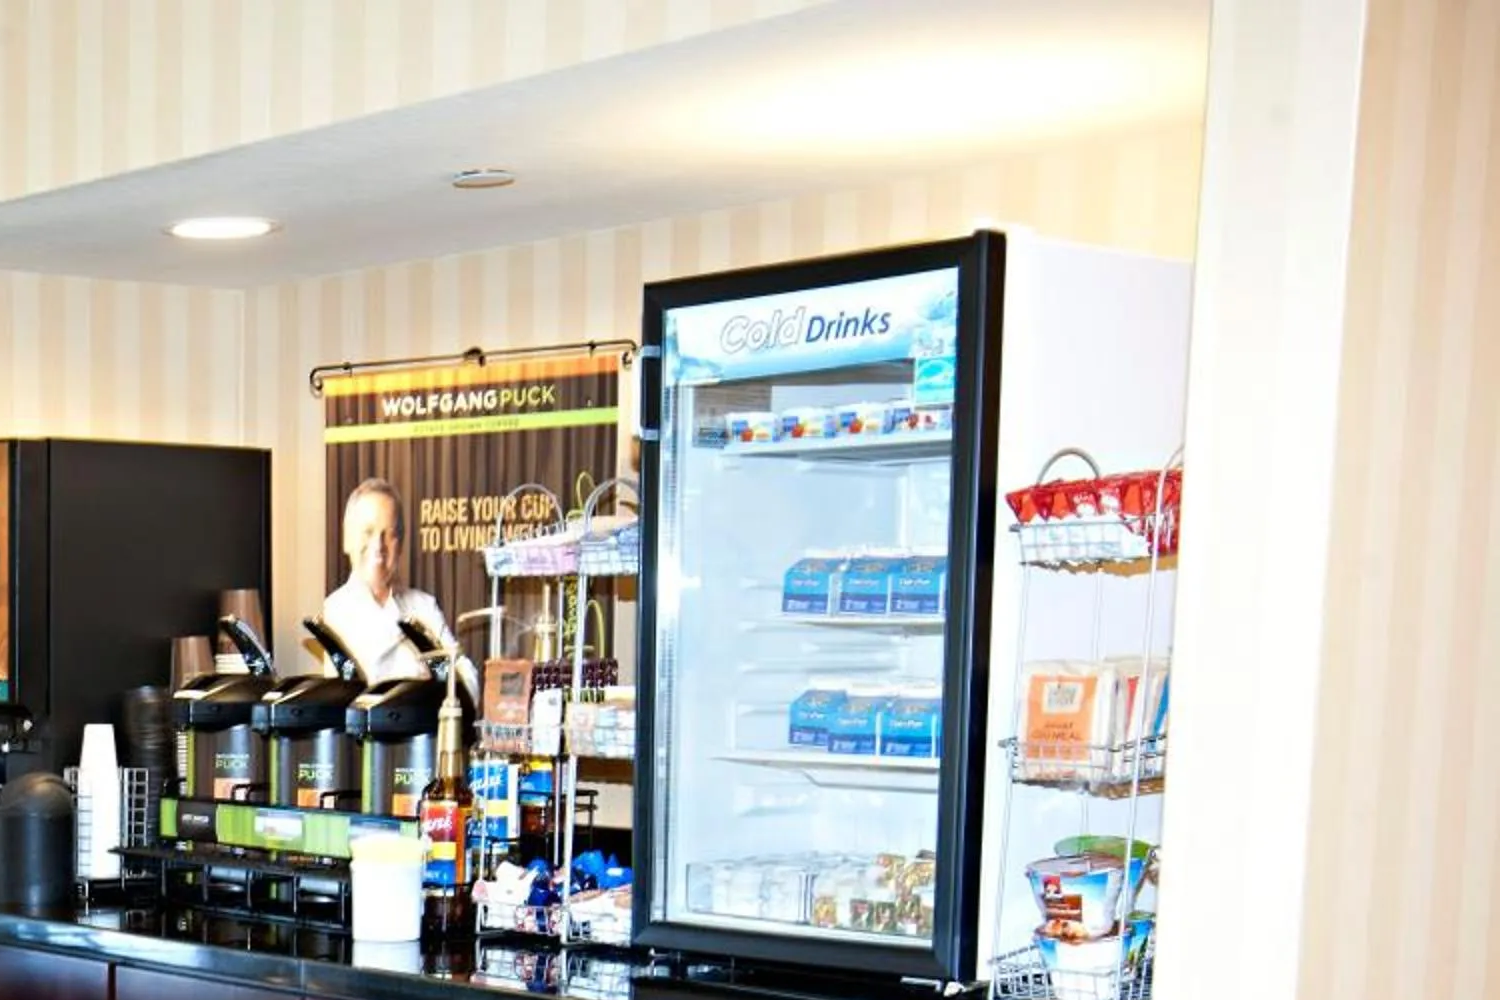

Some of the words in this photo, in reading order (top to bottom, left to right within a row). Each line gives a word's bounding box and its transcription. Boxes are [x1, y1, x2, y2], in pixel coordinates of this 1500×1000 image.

[720, 306, 806, 354] Cold
[805, 307, 892, 343] Drinks
[420, 497, 469, 525] RAISE
[471, 494, 517, 522] YOUR
[520, 493, 556, 520] CUP
[420, 525, 442, 553] TO
